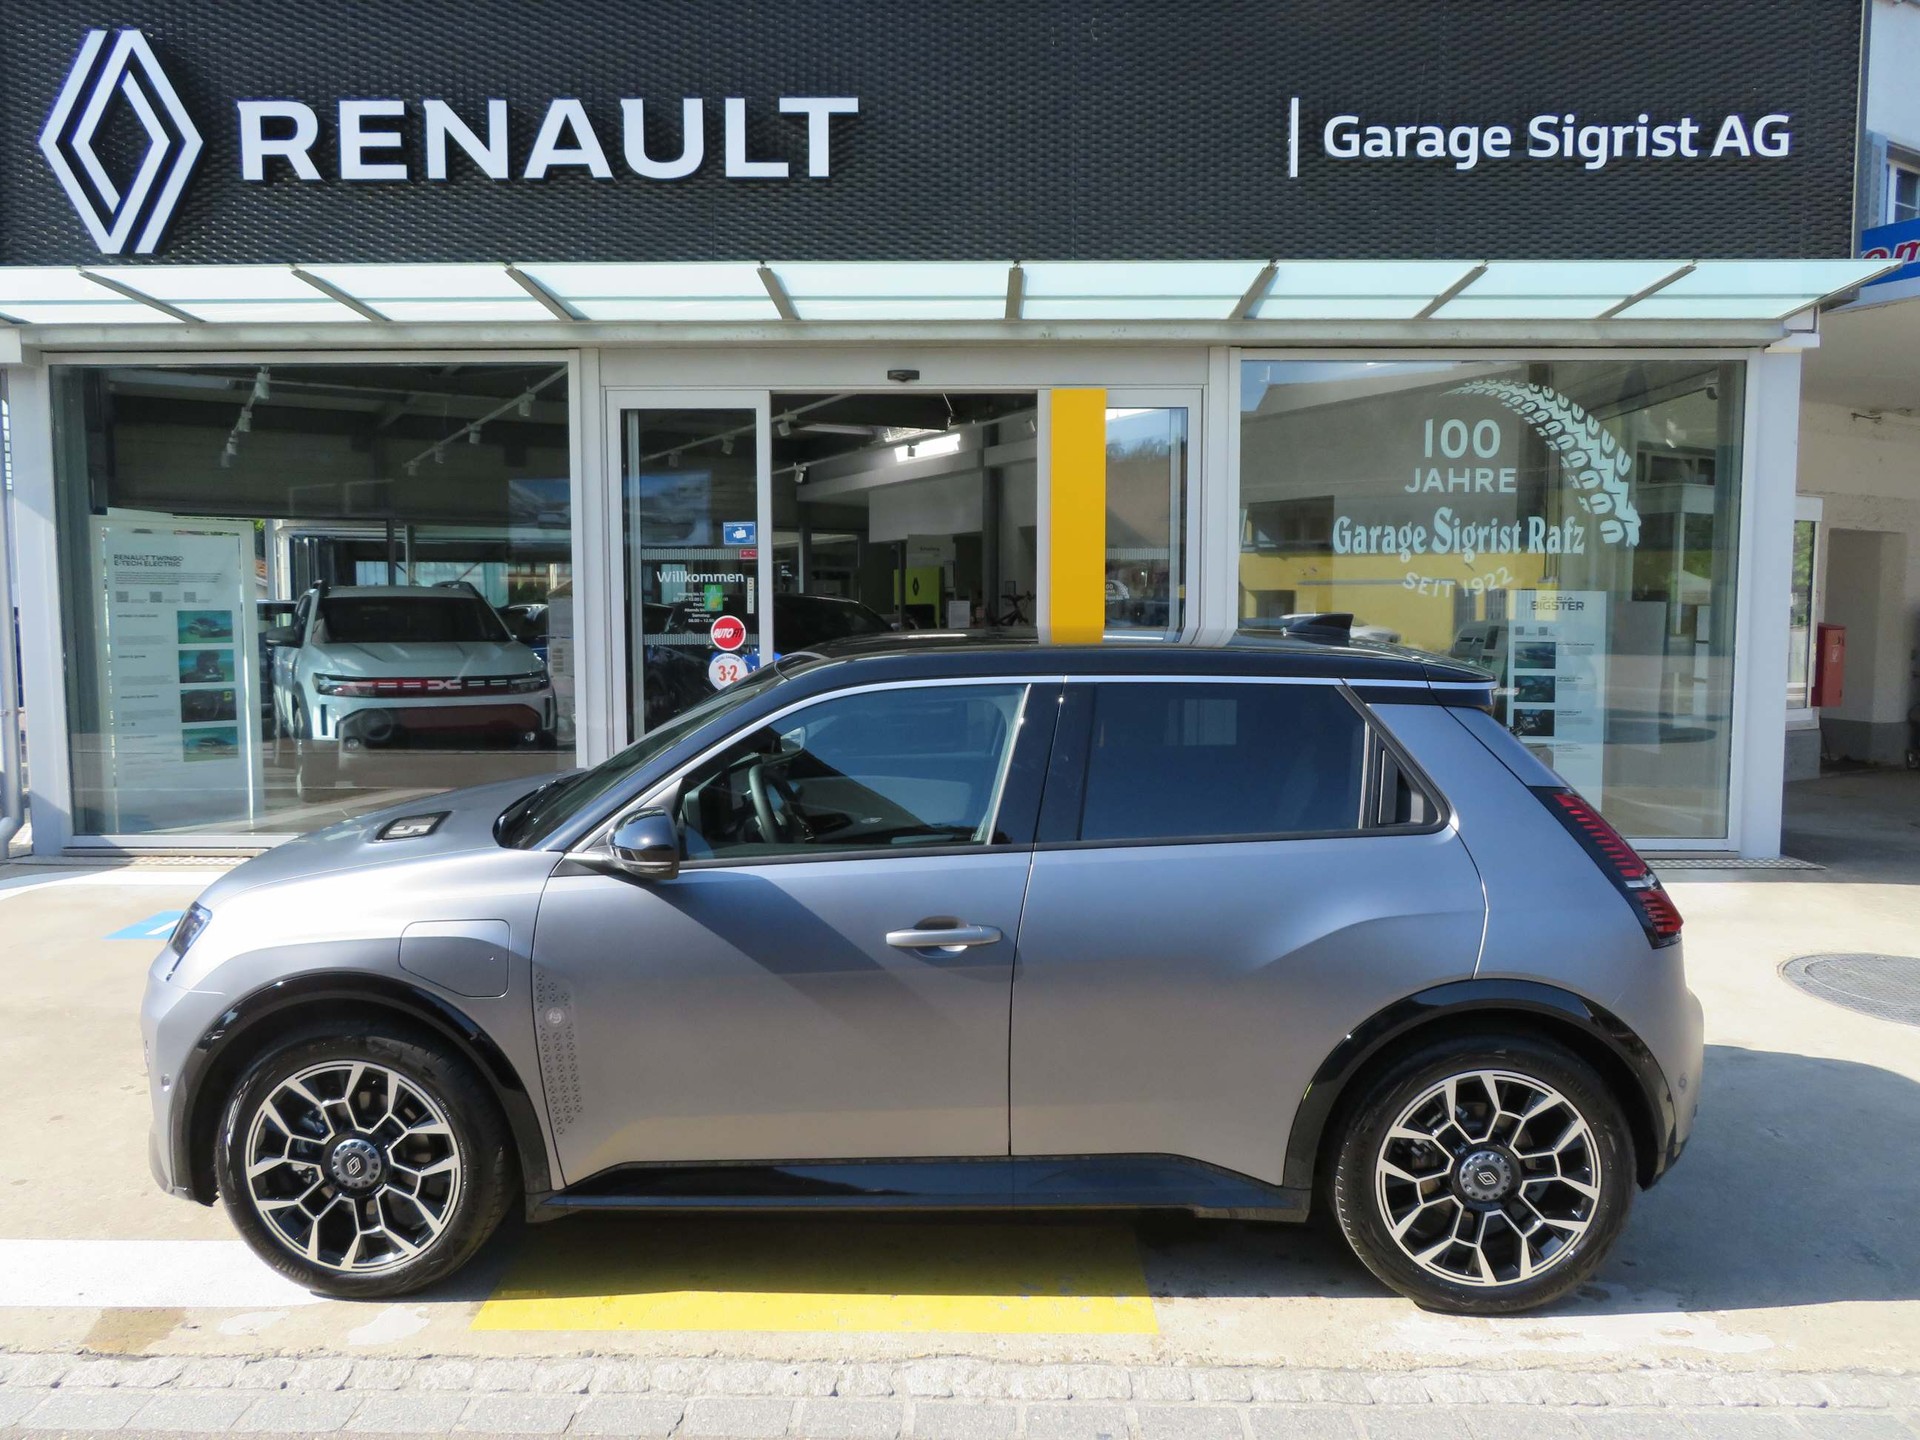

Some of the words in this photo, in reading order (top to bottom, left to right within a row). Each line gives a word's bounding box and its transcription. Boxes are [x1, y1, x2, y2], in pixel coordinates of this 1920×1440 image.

[238, 98, 859, 181] RENAULT
[1323, 115, 1511, 170] Garage
[1527, 113, 1698, 170] Sigrist
[1709, 114, 1790, 157] AG
[1424, 418, 1501, 459] 100
[1404, 467, 1517, 493] JAHRE
[1332, 516, 1427, 563] Garage
[1431, 506, 1522, 563] Sigrist
[1527, 516, 1585, 555] Rafz
[656, 570, 744, 583] Willkommen
[1402, 572, 1455, 598] SEIT
[1463, 567, 1514, 597] 1922
[1531, 600, 1585, 611] BIGSTER
